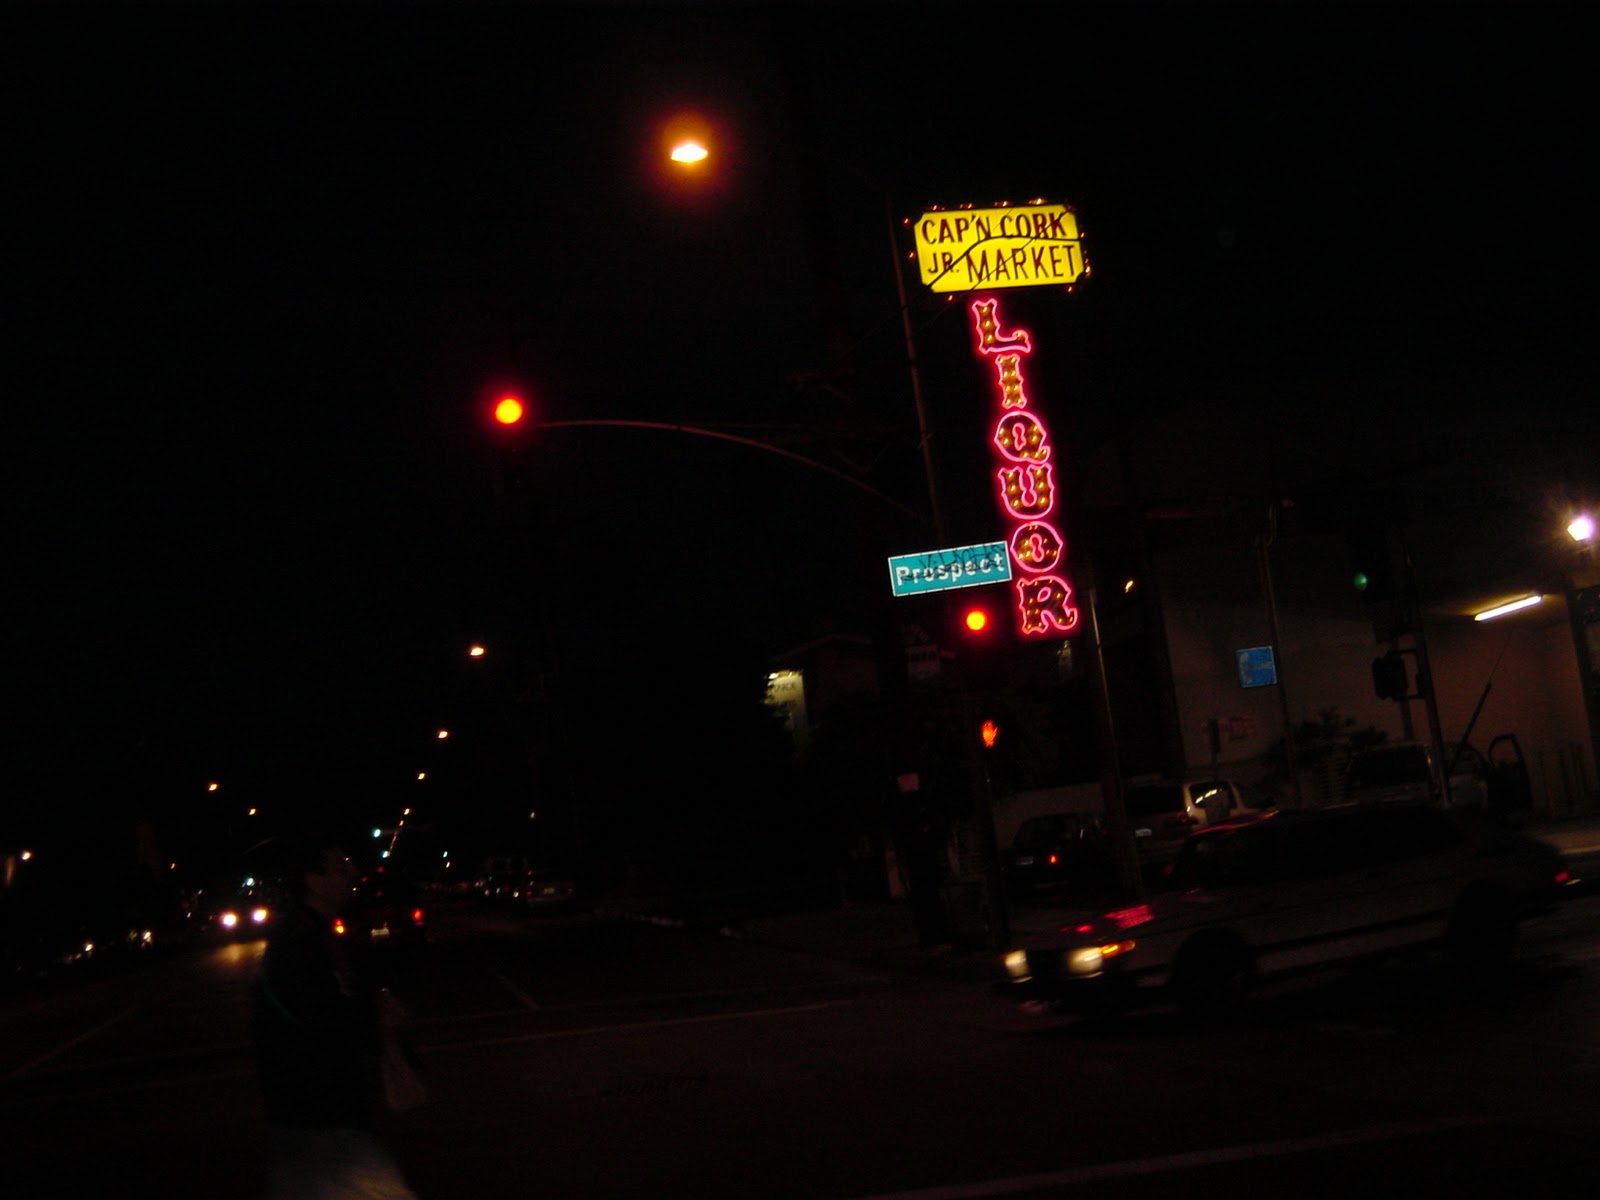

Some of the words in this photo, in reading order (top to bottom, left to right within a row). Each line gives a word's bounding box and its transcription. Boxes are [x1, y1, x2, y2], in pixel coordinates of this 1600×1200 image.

[922, 213, 991, 245] CAP'N
[999, 211, 1067, 240] CORK
[966, 244, 1075, 283] MARKET
[971, 297, 1078, 636] LIQUOR
[895, 553, 1005, 586] Prospect
